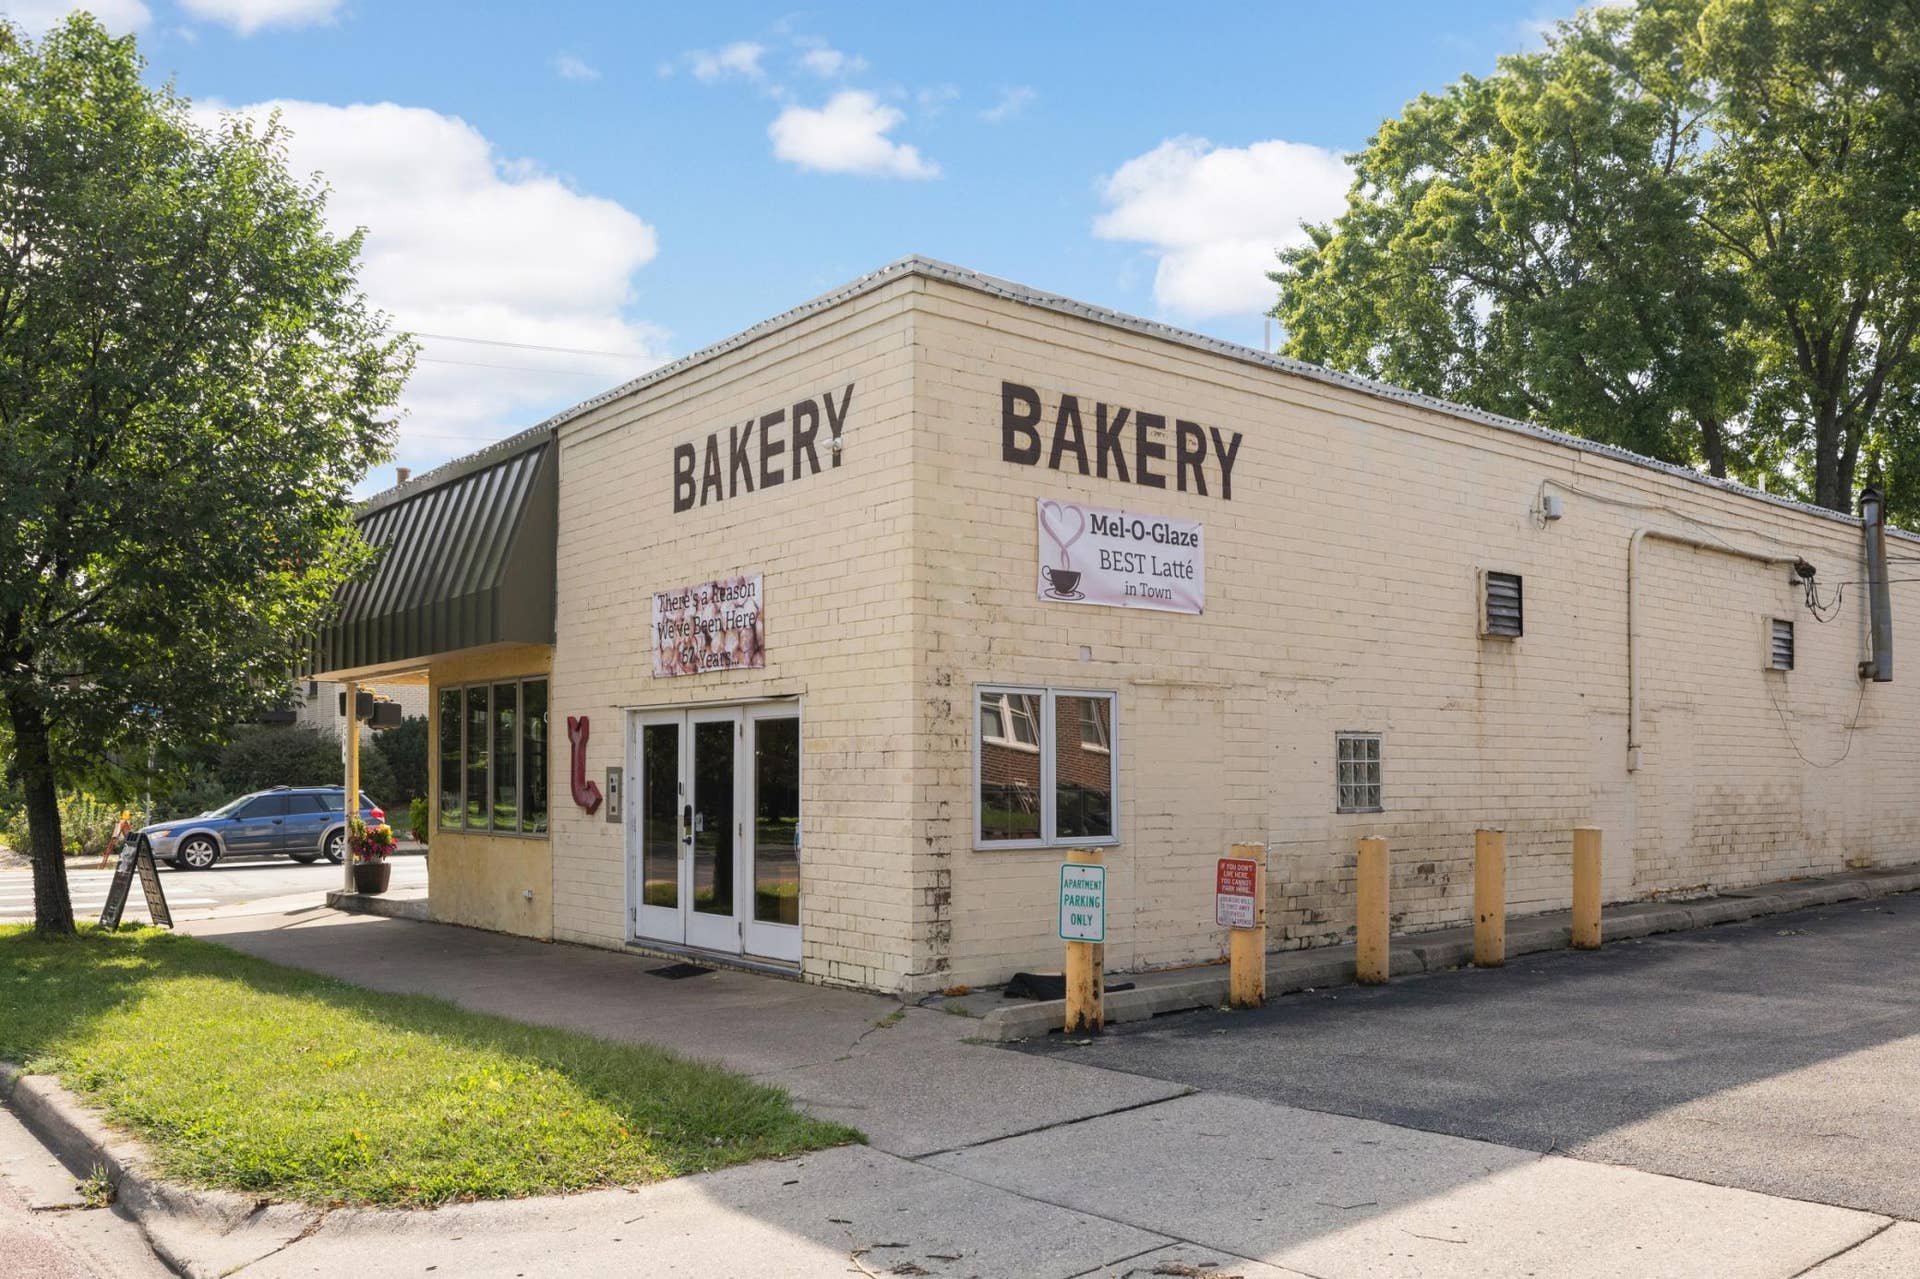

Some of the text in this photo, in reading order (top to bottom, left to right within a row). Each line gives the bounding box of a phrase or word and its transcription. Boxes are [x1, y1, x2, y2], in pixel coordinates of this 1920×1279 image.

[673, 382, 855, 514] BAKERY
[1002, 381, 1243, 500] BAKERY
[1090, 513, 1198, 548] Mel-O-Glaze
[1099, 549, 1193, 580] BEST Latté
[658, 581, 756, 613] There's a Reason
[1125, 580, 1172, 600] in Town
[657, 610, 757, 640] We've Been Here
[1064, 879, 1102, 890] APARTMENT
[1064, 894, 1101, 908] PARKING
[1070, 913, 1093, 926] ONLY
